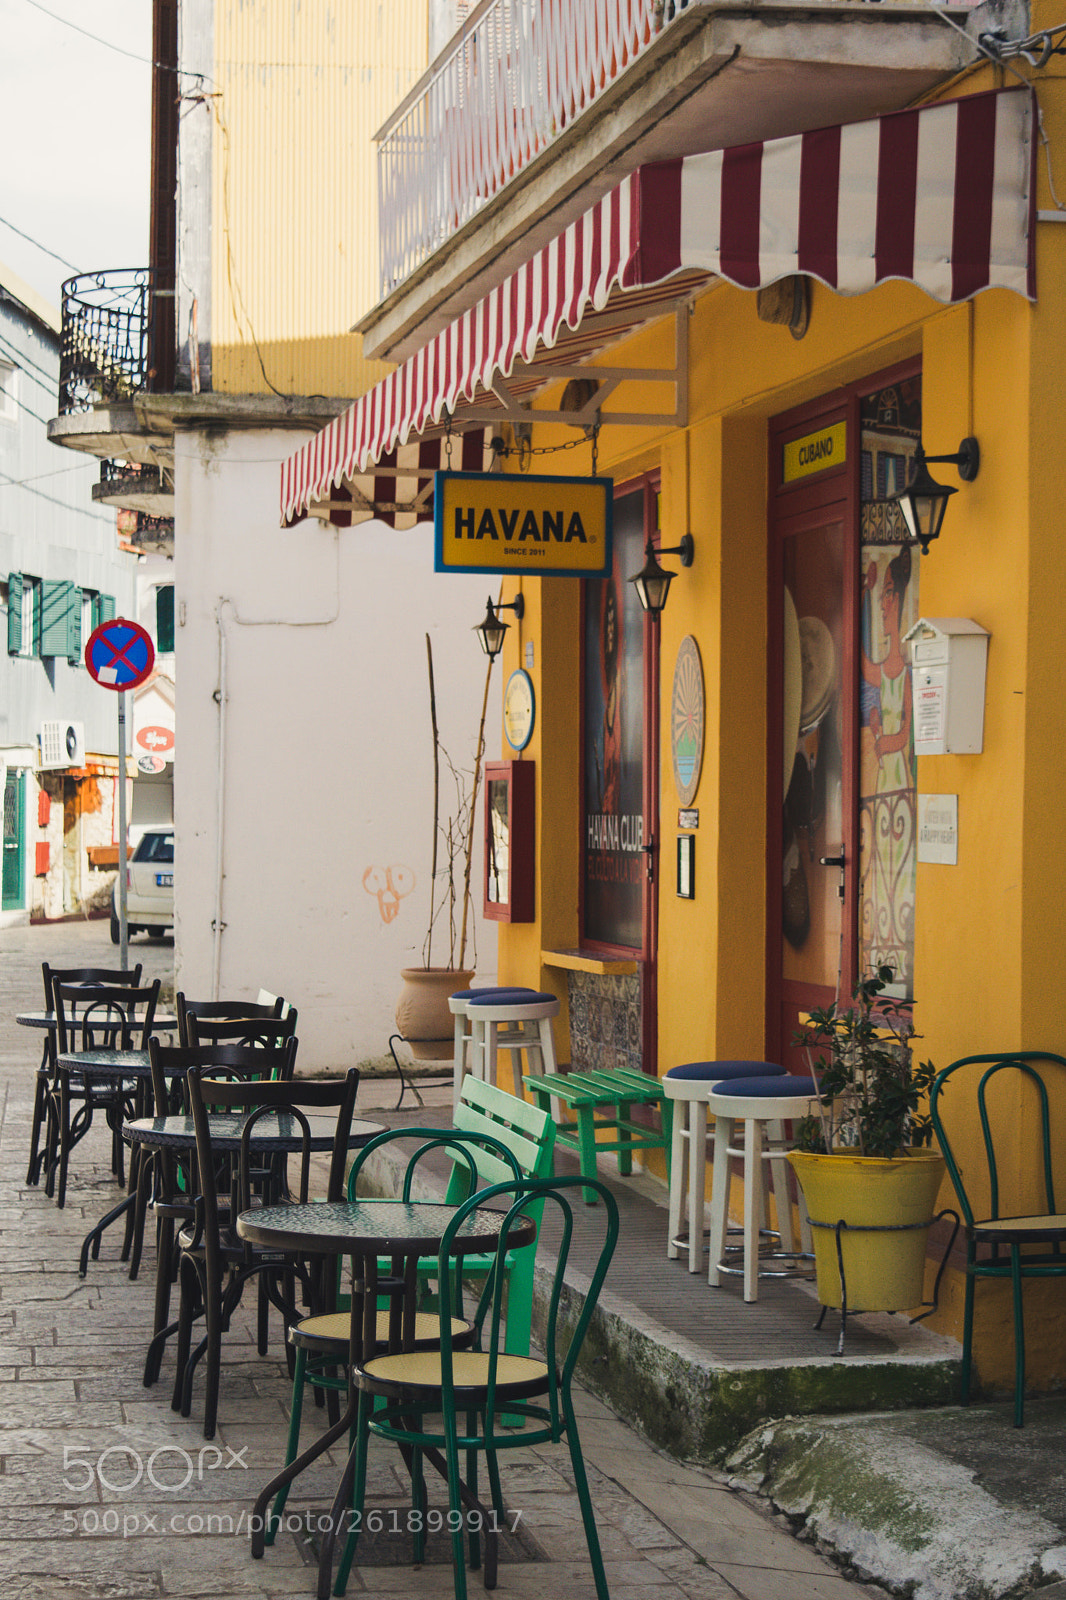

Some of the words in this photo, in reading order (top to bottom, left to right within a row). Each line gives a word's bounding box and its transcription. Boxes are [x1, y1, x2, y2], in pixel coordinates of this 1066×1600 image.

[799, 437, 833, 466] CUBANO
[454, 507, 588, 543] HAVANA
[503, 547, 527, 556] SINCE
[529, 548, 546, 556] 2011
[588, 815, 619, 850] HAVANA
[621, 815, 646, 852] CLUB
